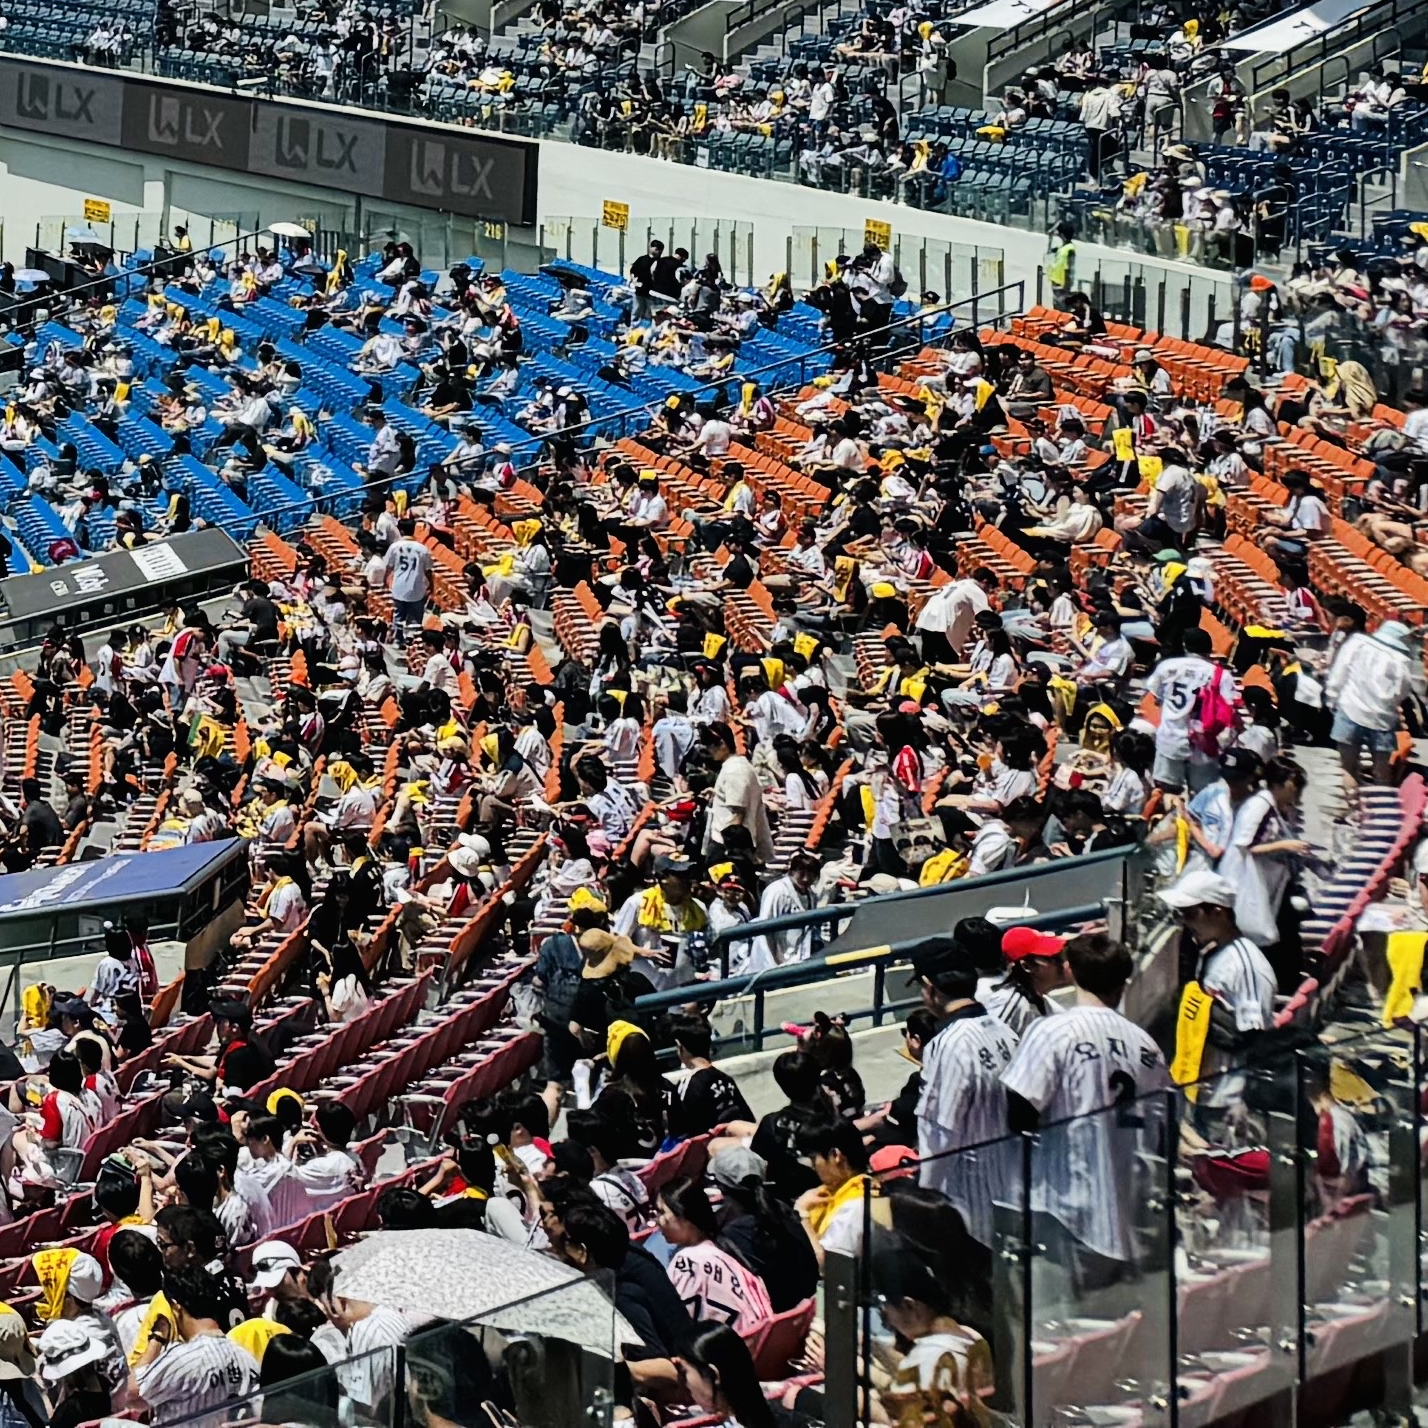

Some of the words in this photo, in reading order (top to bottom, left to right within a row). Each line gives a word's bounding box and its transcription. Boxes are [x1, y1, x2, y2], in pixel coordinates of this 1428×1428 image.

[53, 82, 96, 125] LX
[184, 104, 225, 150] LX
[316, 130, 359, 174] LX
[449, 154, 496, 201] LX
